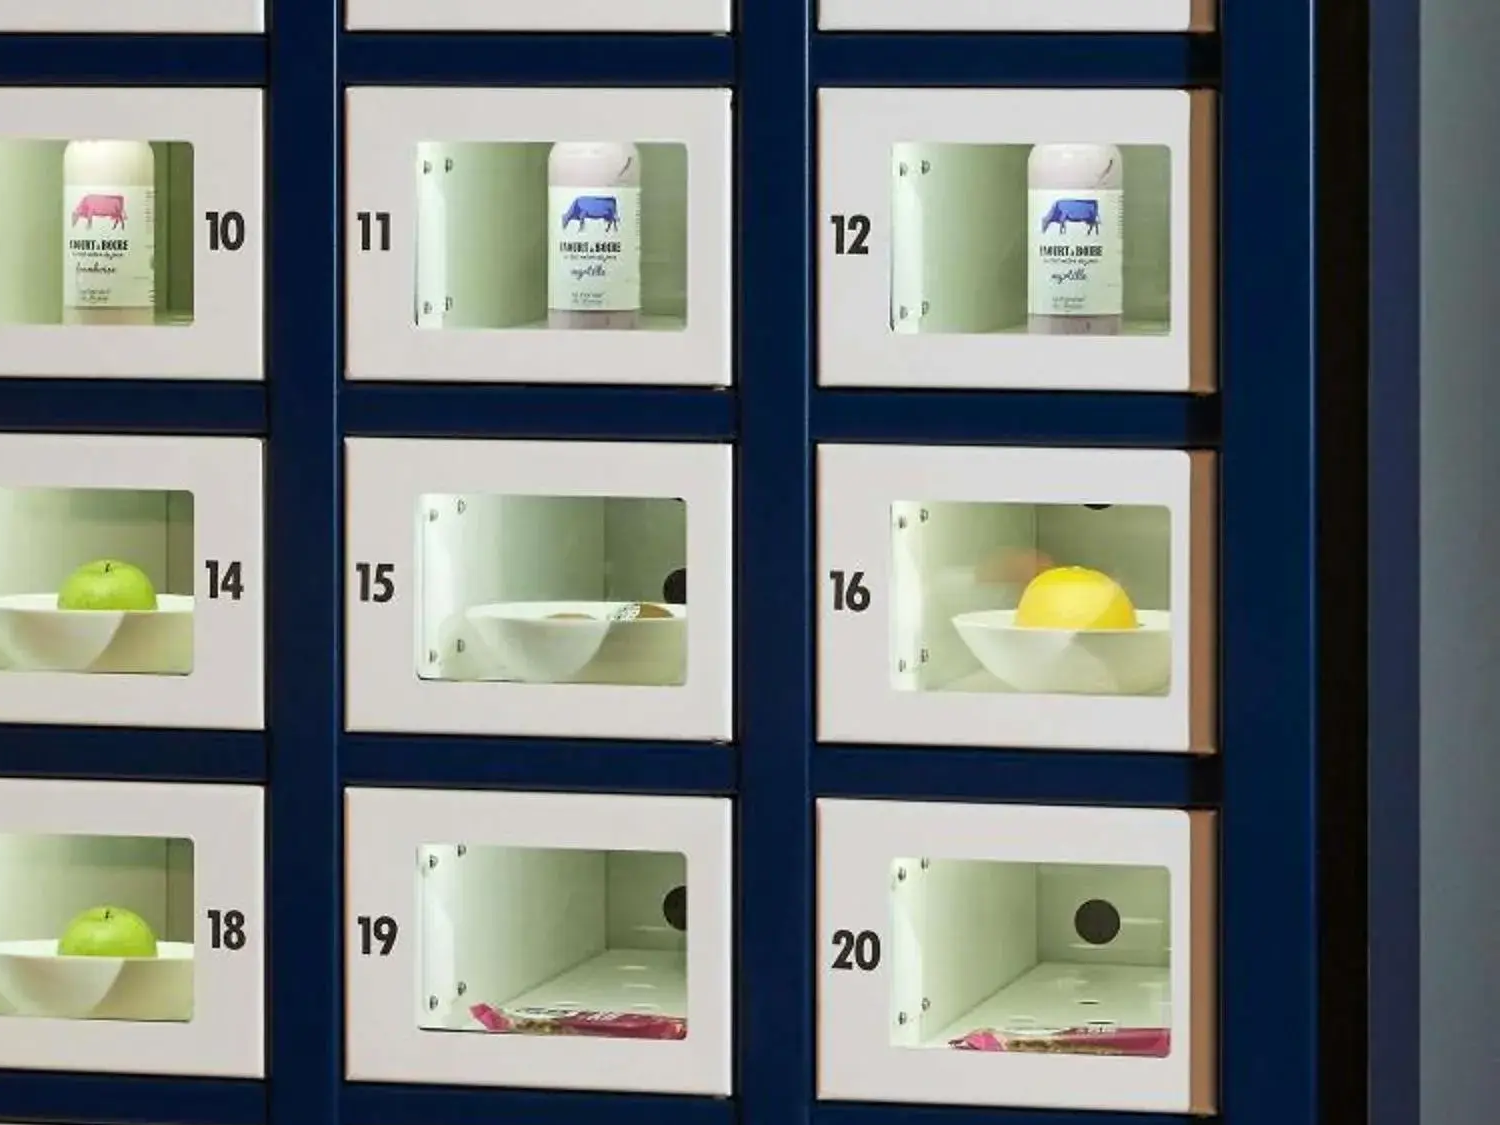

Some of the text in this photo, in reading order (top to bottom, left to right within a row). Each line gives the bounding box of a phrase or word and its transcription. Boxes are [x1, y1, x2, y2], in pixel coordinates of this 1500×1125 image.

[205, 211, 245, 251] 10
[357, 211, 390, 251] 11
[830, 214, 871, 256] 12
[205, 559, 244, 600] 14
[355, 562, 395, 603] 15
[830, 569, 871, 612] 16
[207, 909, 246, 951] 18
[357, 915, 398, 956] 19
[831, 929, 881, 971] 20
